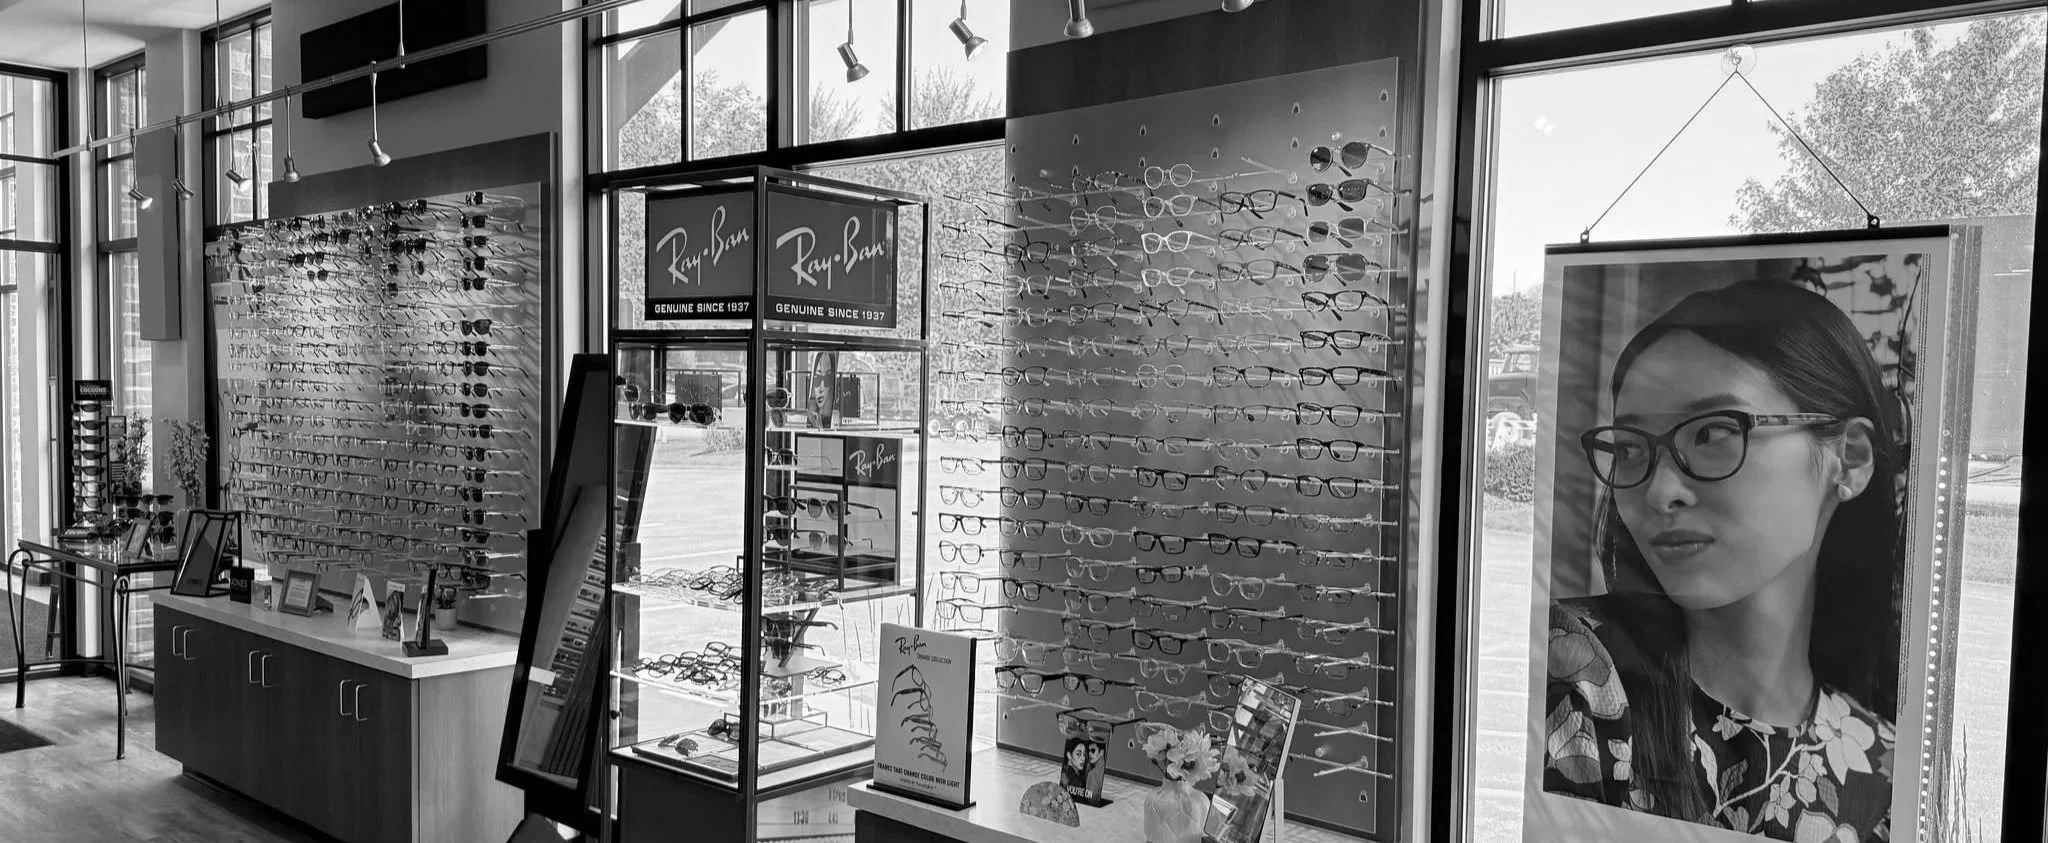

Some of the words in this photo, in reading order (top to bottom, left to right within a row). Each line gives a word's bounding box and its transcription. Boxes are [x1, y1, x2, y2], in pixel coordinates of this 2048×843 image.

[654, 303, 694, 314] GENUINE
[696, 302, 725, 313] SINCE
[727, 302, 750, 312] 1937
[775, 303, 824, 317] GENUINE
[828, 307, 859, 319] SINCE
[862, 310, 885, 321] 1937
[877, 762, 893, 772] FRAMES
[893, 766, 903, 774] THAT
[903, 769, 920, 780] CHANGE
[920, 772, 935, 783] COLOR
[935, 776, 946, 785] WITH
[946, 779, 960, 789] LIGHT
